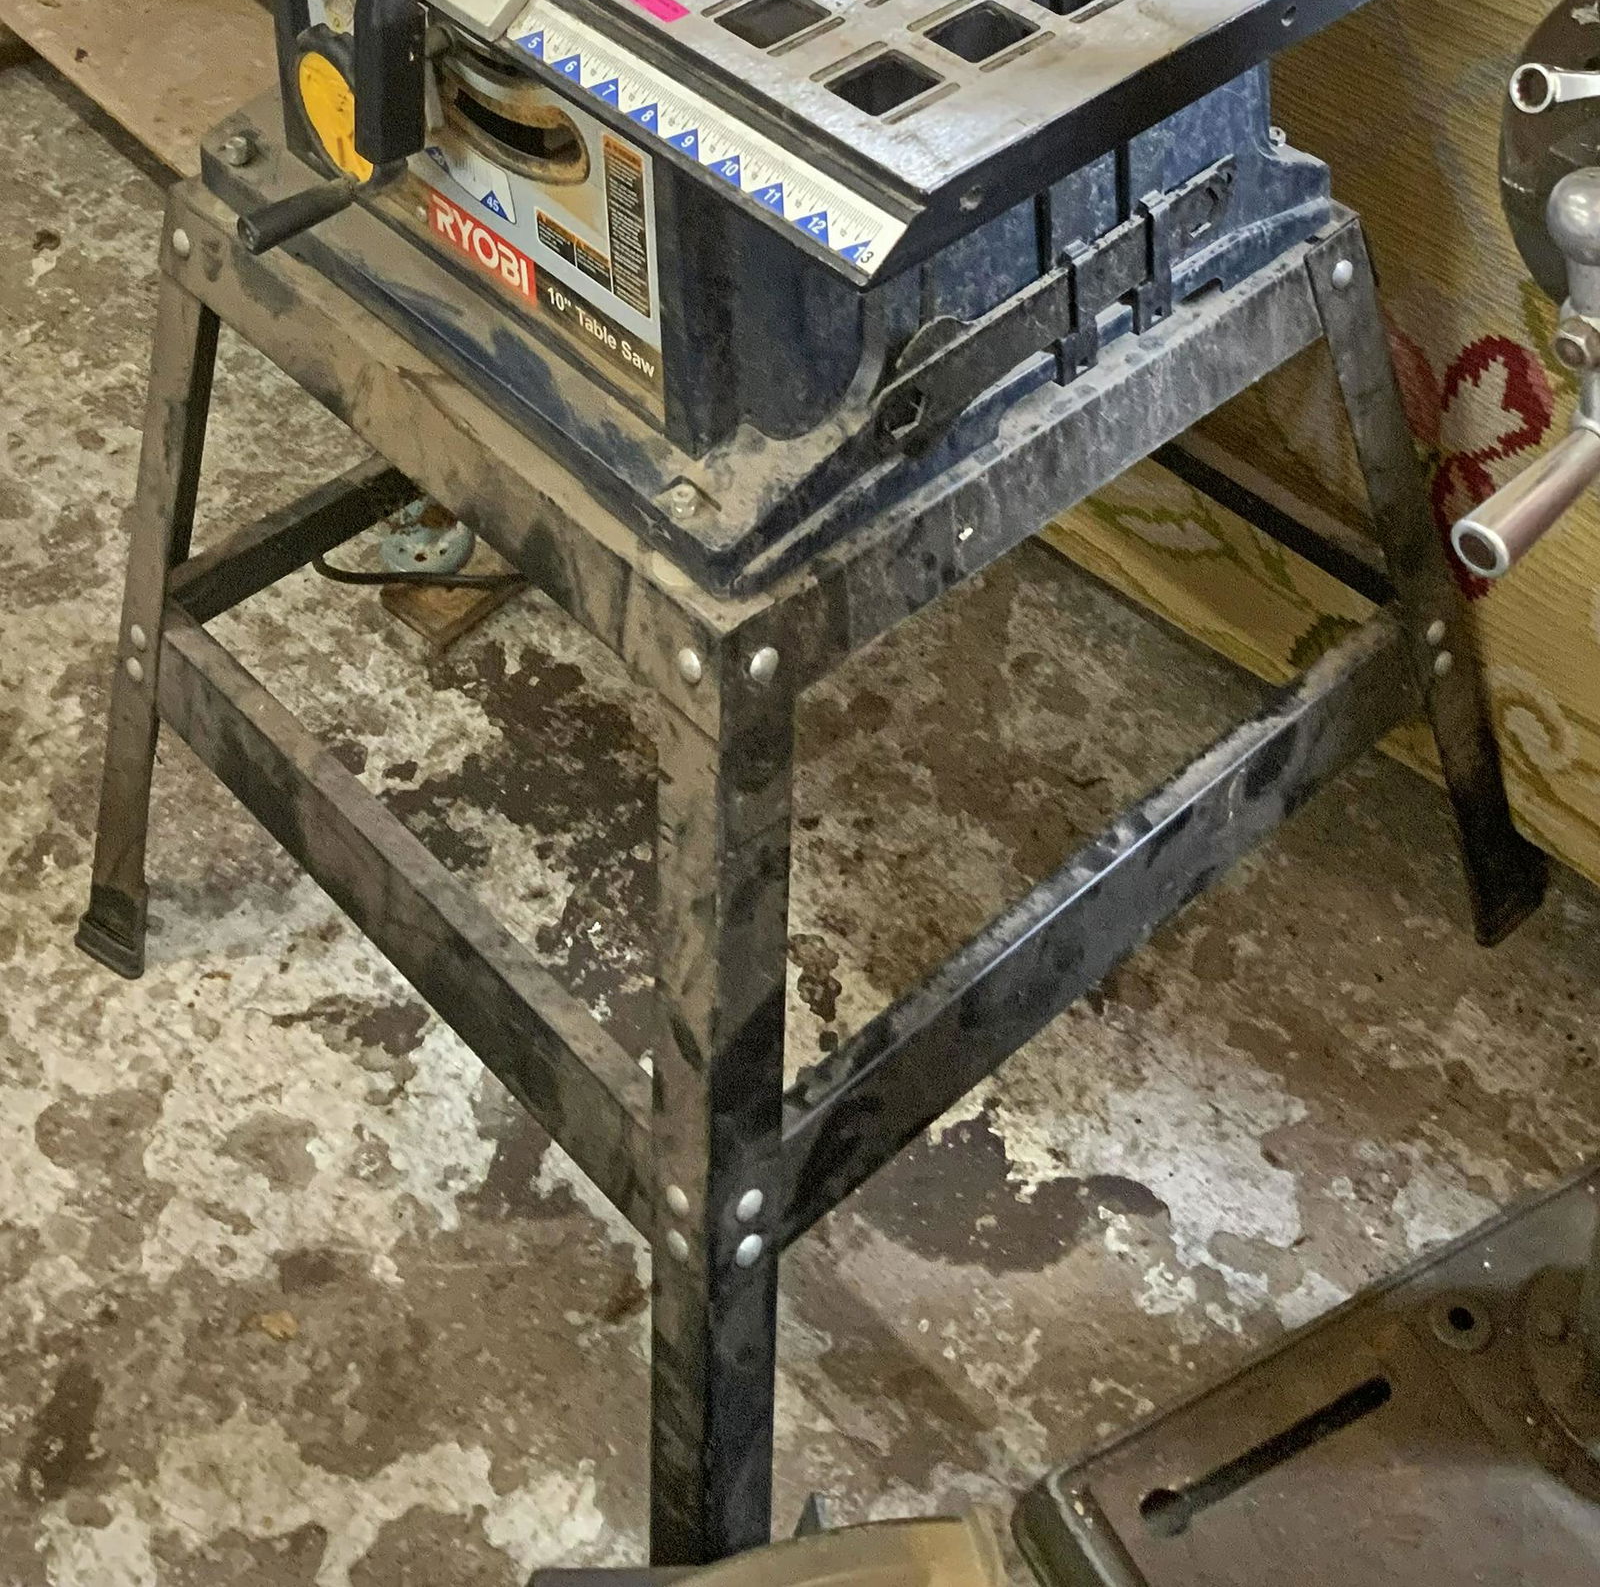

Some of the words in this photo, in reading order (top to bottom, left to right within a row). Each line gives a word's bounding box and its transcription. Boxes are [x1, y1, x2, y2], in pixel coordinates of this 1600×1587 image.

[527, 36, 542, 49] 5
[563, 60, 578, 73] 6
[601, 84, 616, 97] 7
[640, 109, 655, 123] 8
[680, 135, 695, 148] 9
[720, 160, 739, 177] 10
[763, 188, 782, 204] 11
[806, 212, 827, 234] 12
[852, 245, 874, 264] 13
[432, 193, 530, 296] RYOBI
[486, 195, 500, 213] 45
[547, 287, 572, 312] 10"
[574, 304, 617, 350] Table
[620, 340, 655, 378] Saw
